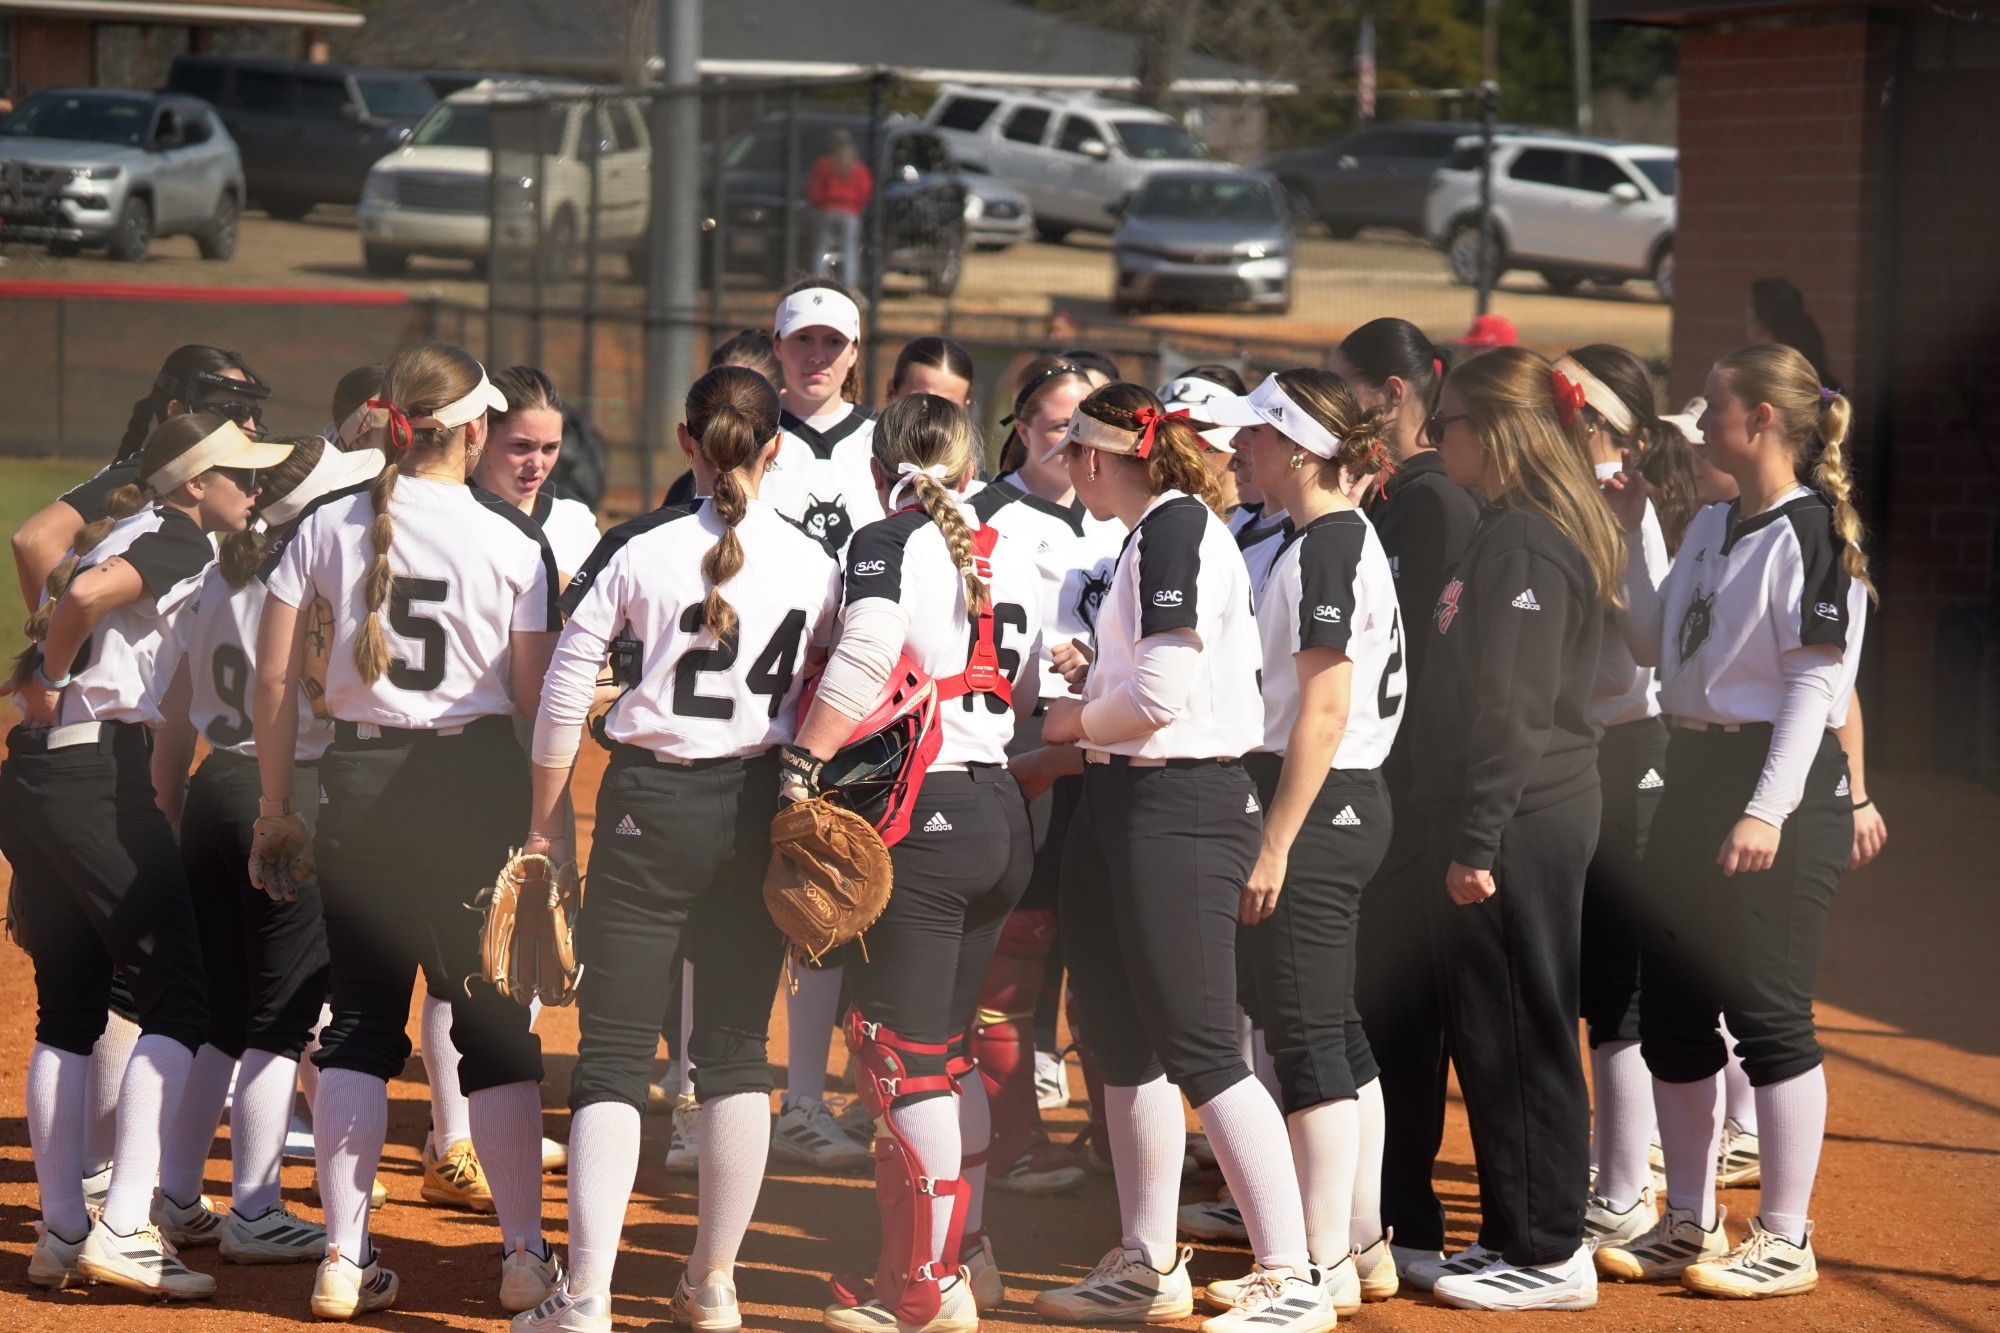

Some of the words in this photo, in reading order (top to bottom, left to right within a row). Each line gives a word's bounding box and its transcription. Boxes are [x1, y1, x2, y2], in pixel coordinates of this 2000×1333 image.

[857, 559, 886, 572] SAC
[1155, 589, 1183, 602] SAC
[1315, 604, 1341, 619] SAC
[1511, 600, 1541, 611] adidas
[1818, 602, 1839, 616] SA
[386, 576, 449, 692] 5
[672, 602, 807, 720] 24
[206, 642, 254, 747] 9
[923, 823, 953, 832] adidas
[1331, 817, 1362, 826] adidas
[615, 827, 642, 836] adidas
